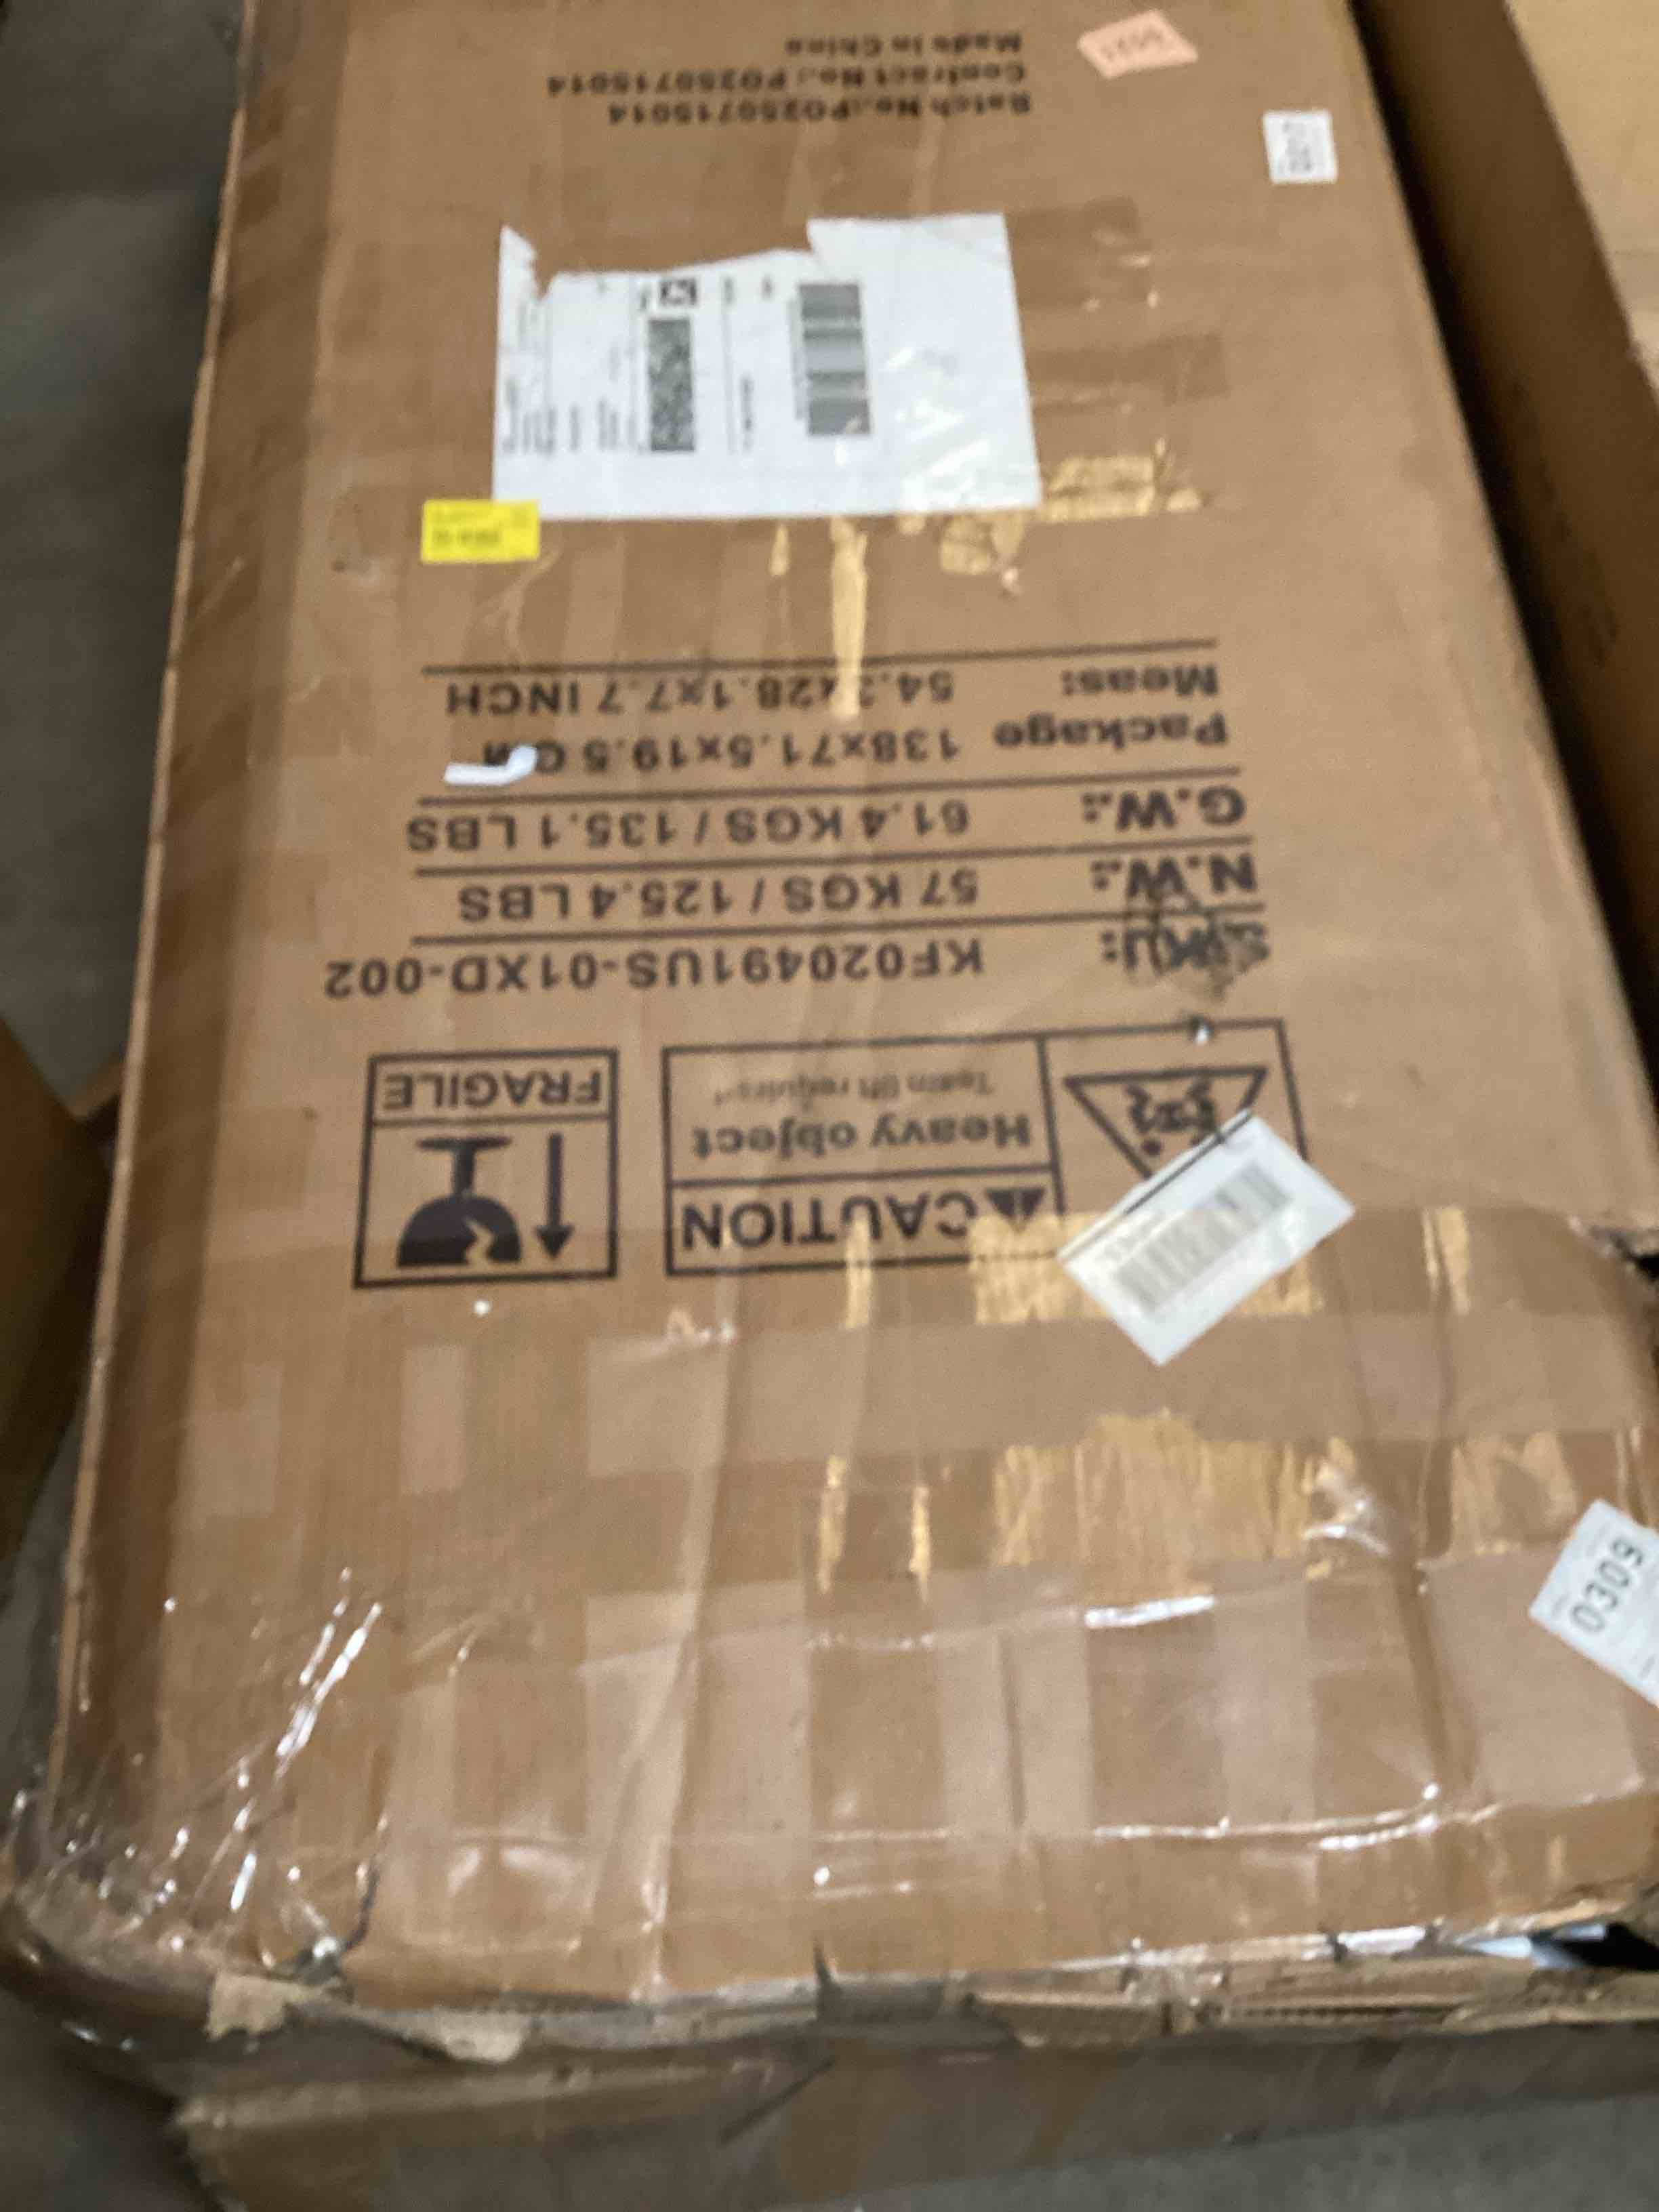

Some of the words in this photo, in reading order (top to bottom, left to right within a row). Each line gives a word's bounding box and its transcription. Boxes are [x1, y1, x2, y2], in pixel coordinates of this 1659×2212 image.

[446, 684, 579, 716] INCH
[583, 729, 960, 773] 138x71.5x19.5
[994, 713, 1228, 750] Package
[726, 808, 842, 845] KGS
[860, 800, 970, 838] 61.4
[1082, 787, 1246, 833] G.W.:
[405, 817, 516, 853] LBS
[539, 814, 675, 851] 135.1
[783, 874, 900, 913] KGS
[921, 869, 978, 907] 57
[1090, 855, 1256, 902] N.W.:
[457, 884, 569, 924] LBS
[588, 880, 733, 921] 125.4
[324, 940, 984, 998] KF020491US-01XD-002
[383, 1069, 605, 1111] FRAGILE
[693, 1119, 857, 1162] object
[874, 1111, 1031, 1149] Heavy
[681, 1191, 979, 1251] CAUTION
[1572, 1538, 1643, 1632] 0309
